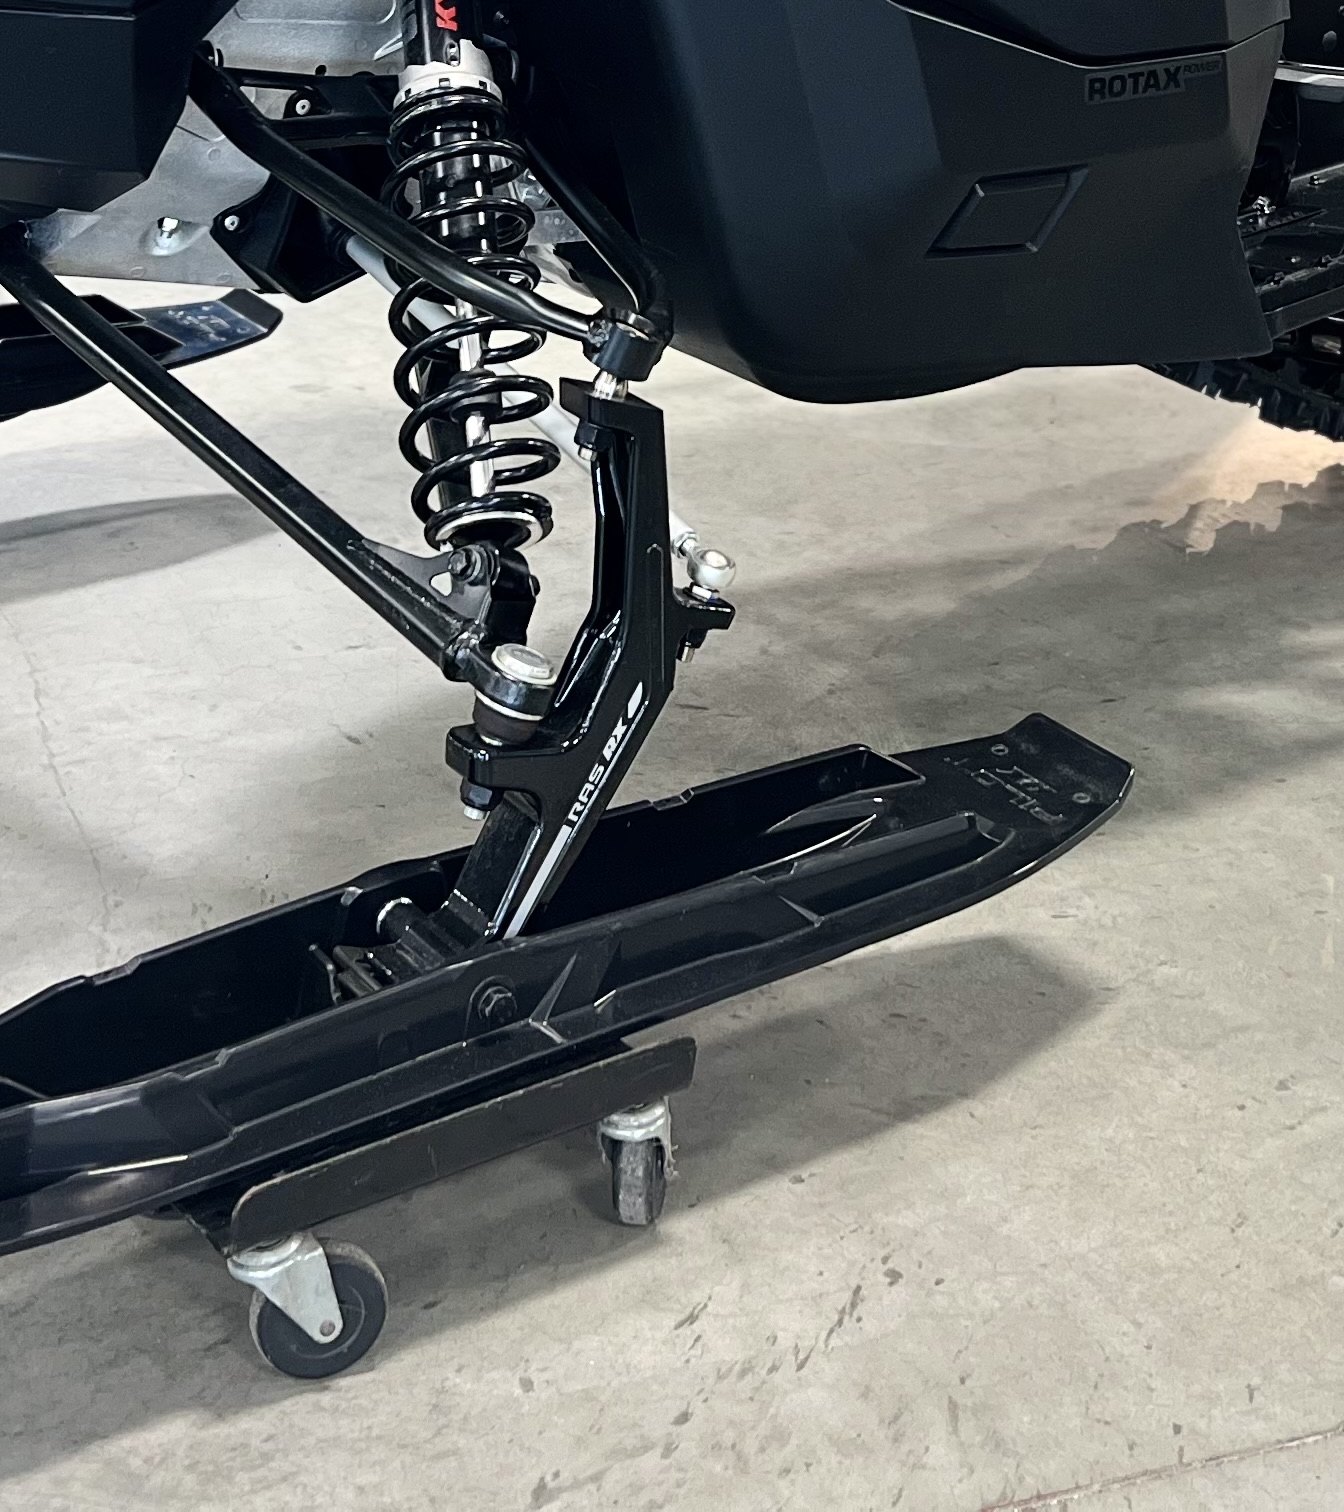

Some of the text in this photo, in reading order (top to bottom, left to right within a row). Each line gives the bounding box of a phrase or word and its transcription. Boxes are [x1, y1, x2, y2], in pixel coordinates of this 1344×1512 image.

[1087, 65, 1182, 102] ROTAX
[567, 716, 628, 822] RAS RX
